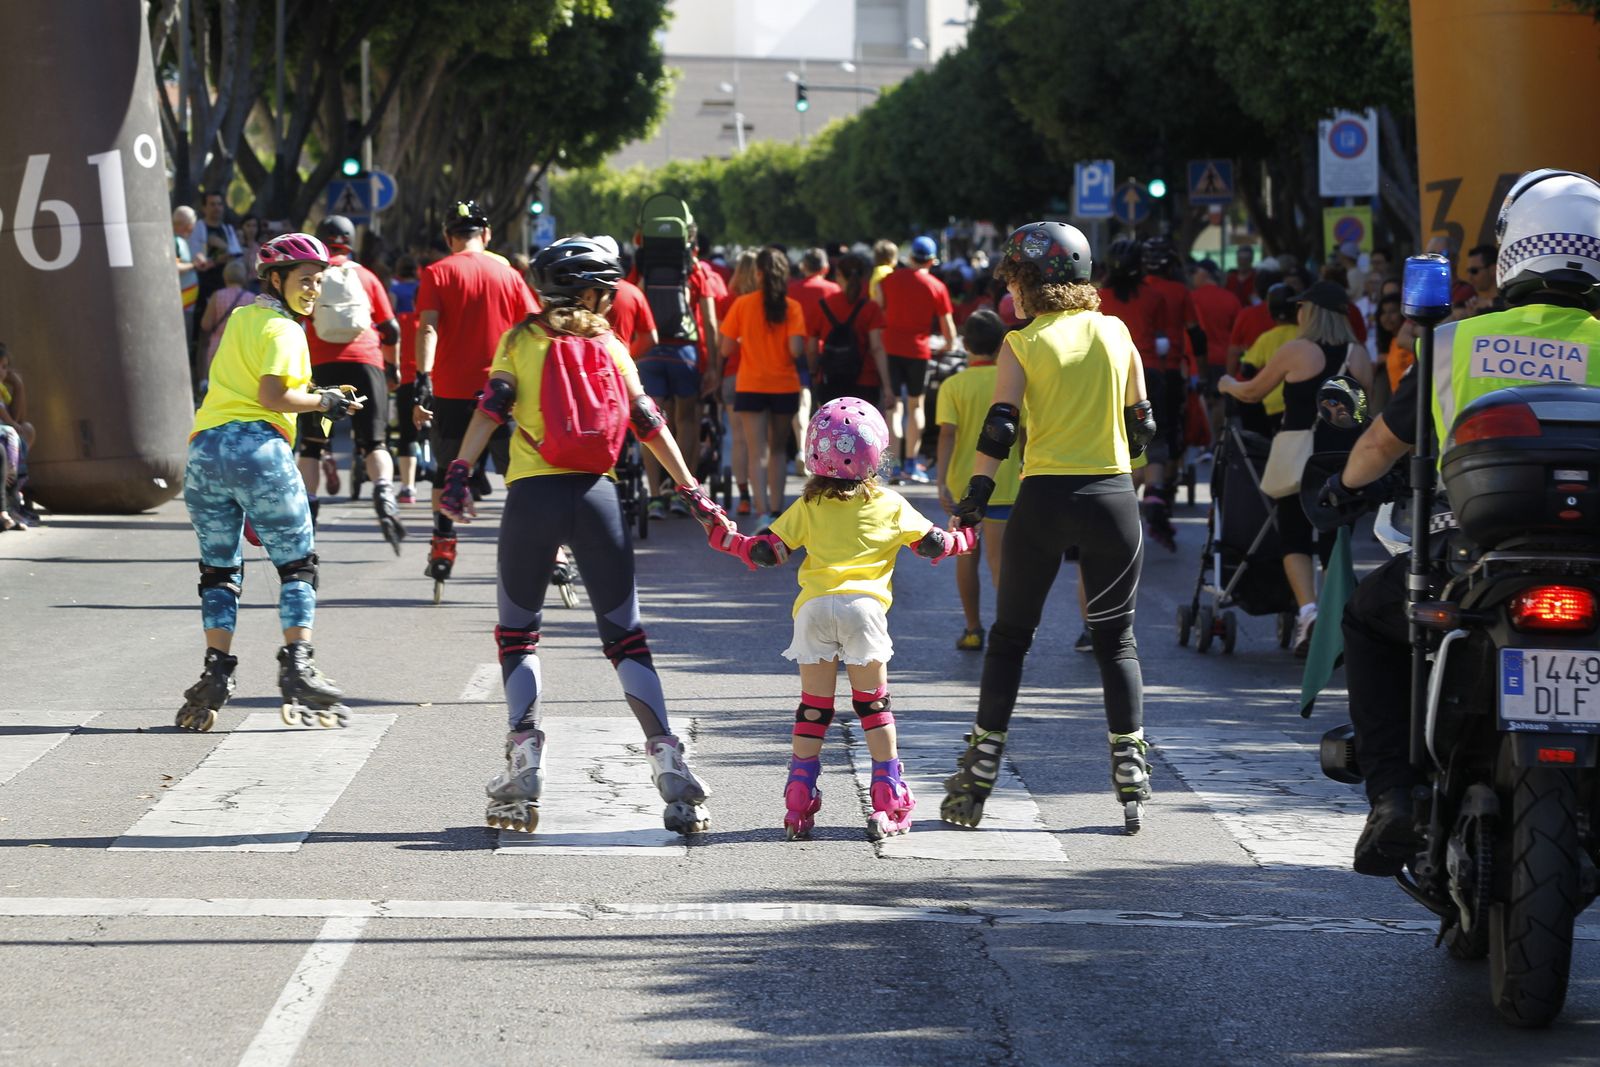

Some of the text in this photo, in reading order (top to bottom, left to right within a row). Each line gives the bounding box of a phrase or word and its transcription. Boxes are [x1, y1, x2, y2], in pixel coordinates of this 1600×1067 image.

[1475, 338, 1583, 363] POLICIA
[1482, 357, 1572, 382] LOCAL
[1508, 676, 1519, 687] E
[1531, 655, 1600, 685] 1449
[1535, 686, 1591, 716] DLF
